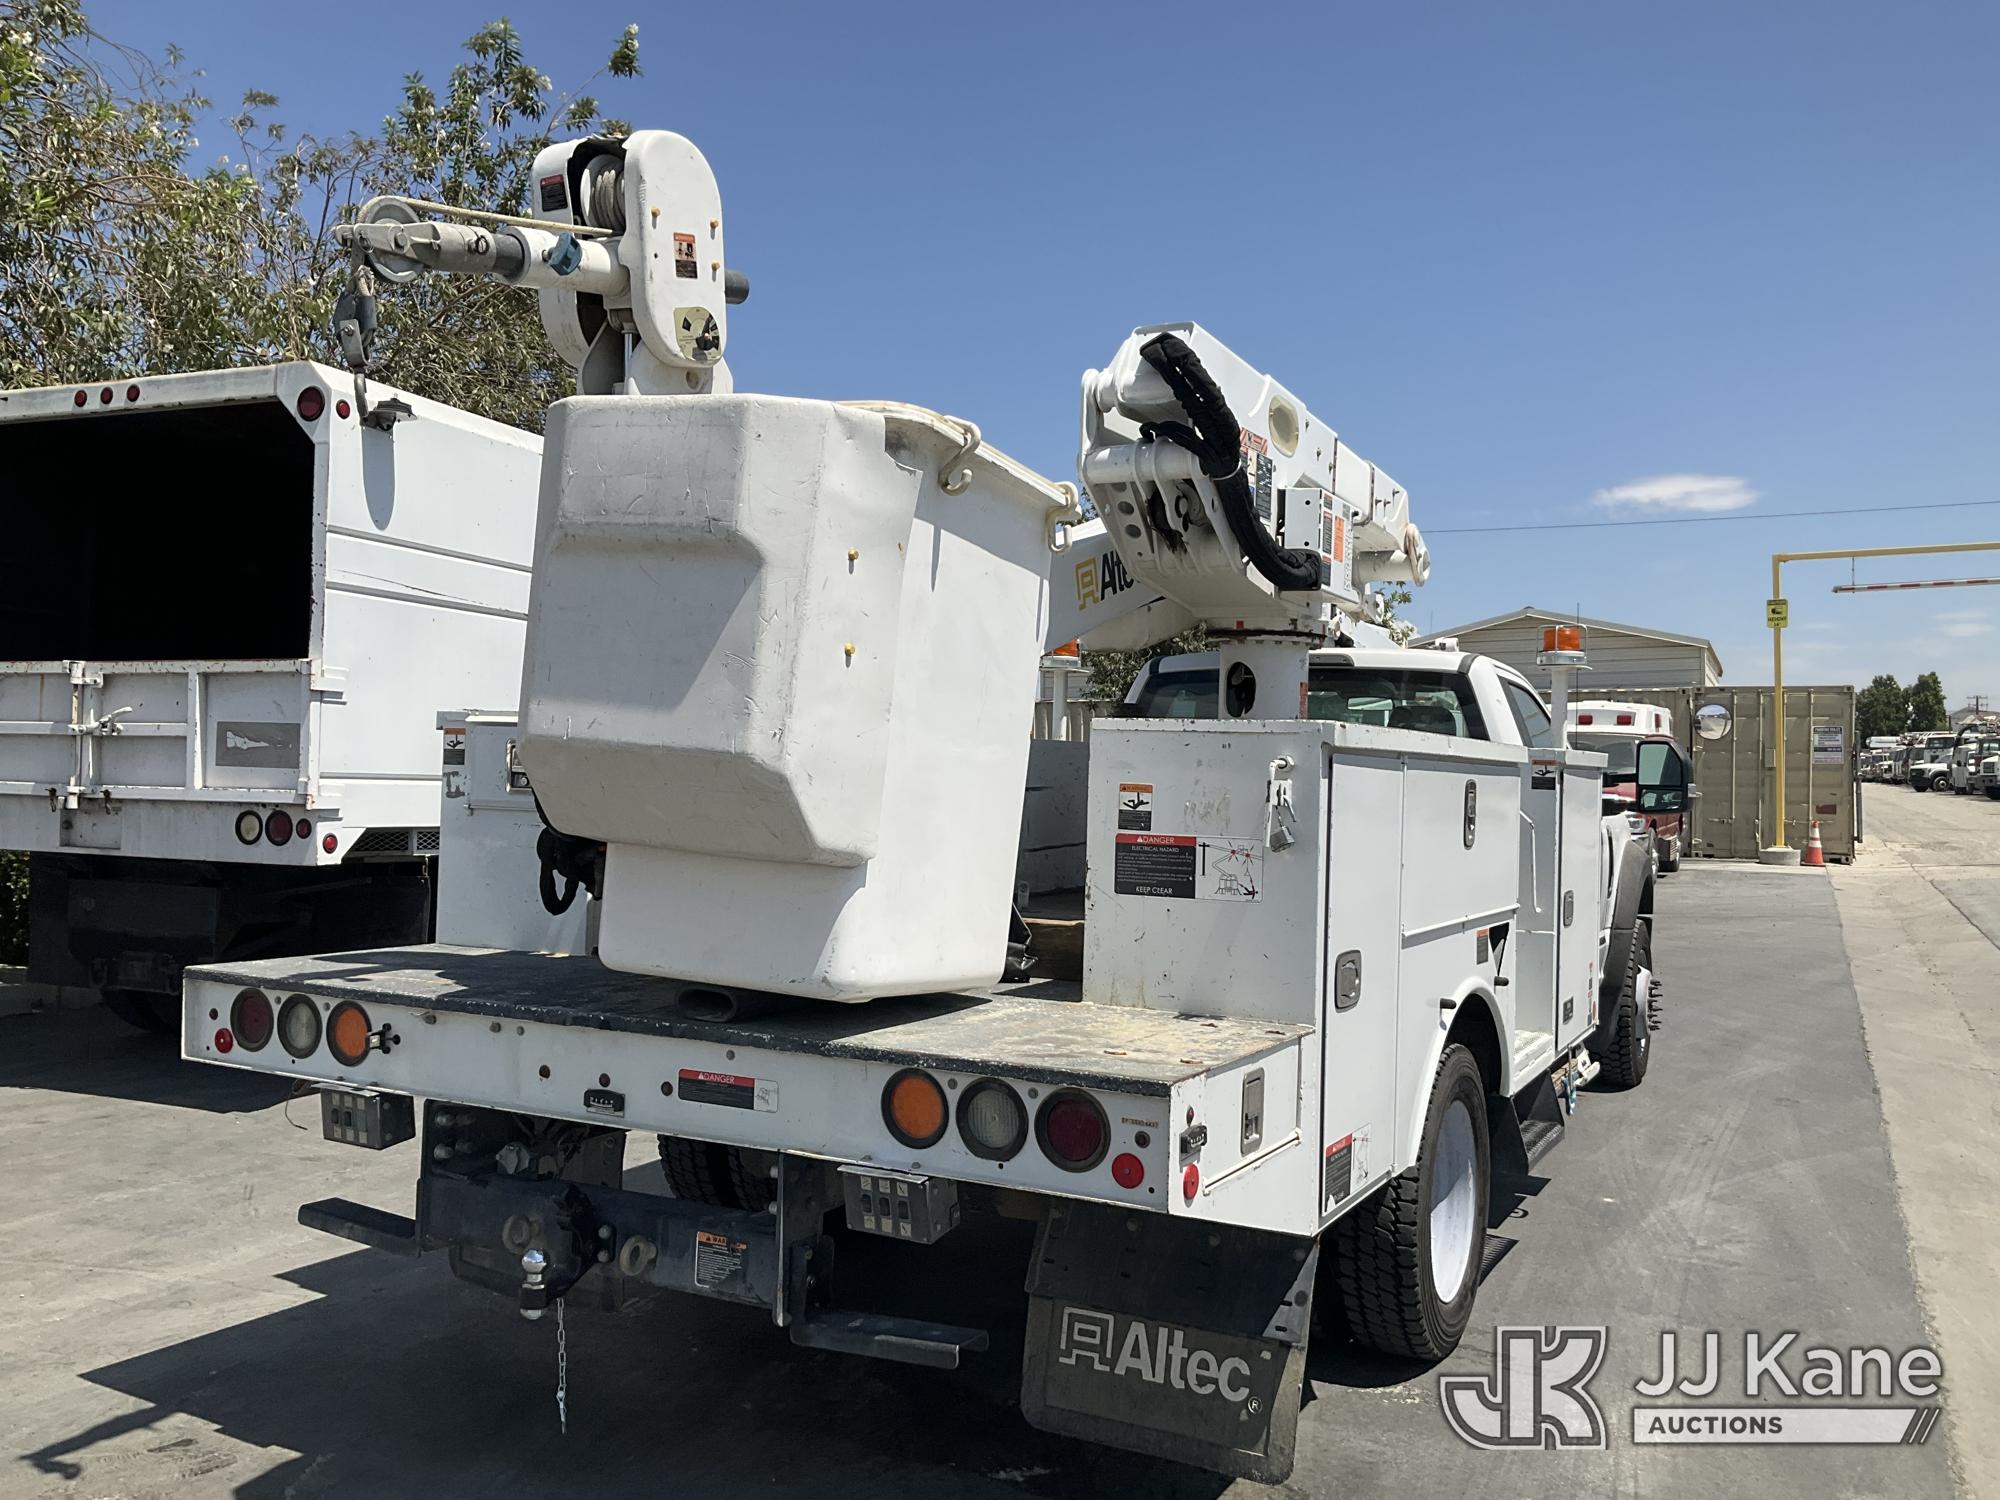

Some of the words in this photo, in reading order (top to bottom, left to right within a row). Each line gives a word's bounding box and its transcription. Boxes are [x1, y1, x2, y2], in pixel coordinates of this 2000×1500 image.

[1142, 836, 1175, 844] DANGER
[703, 1072, 735, 1084] DANGER
[1113, 1320, 1251, 1402] Altec
